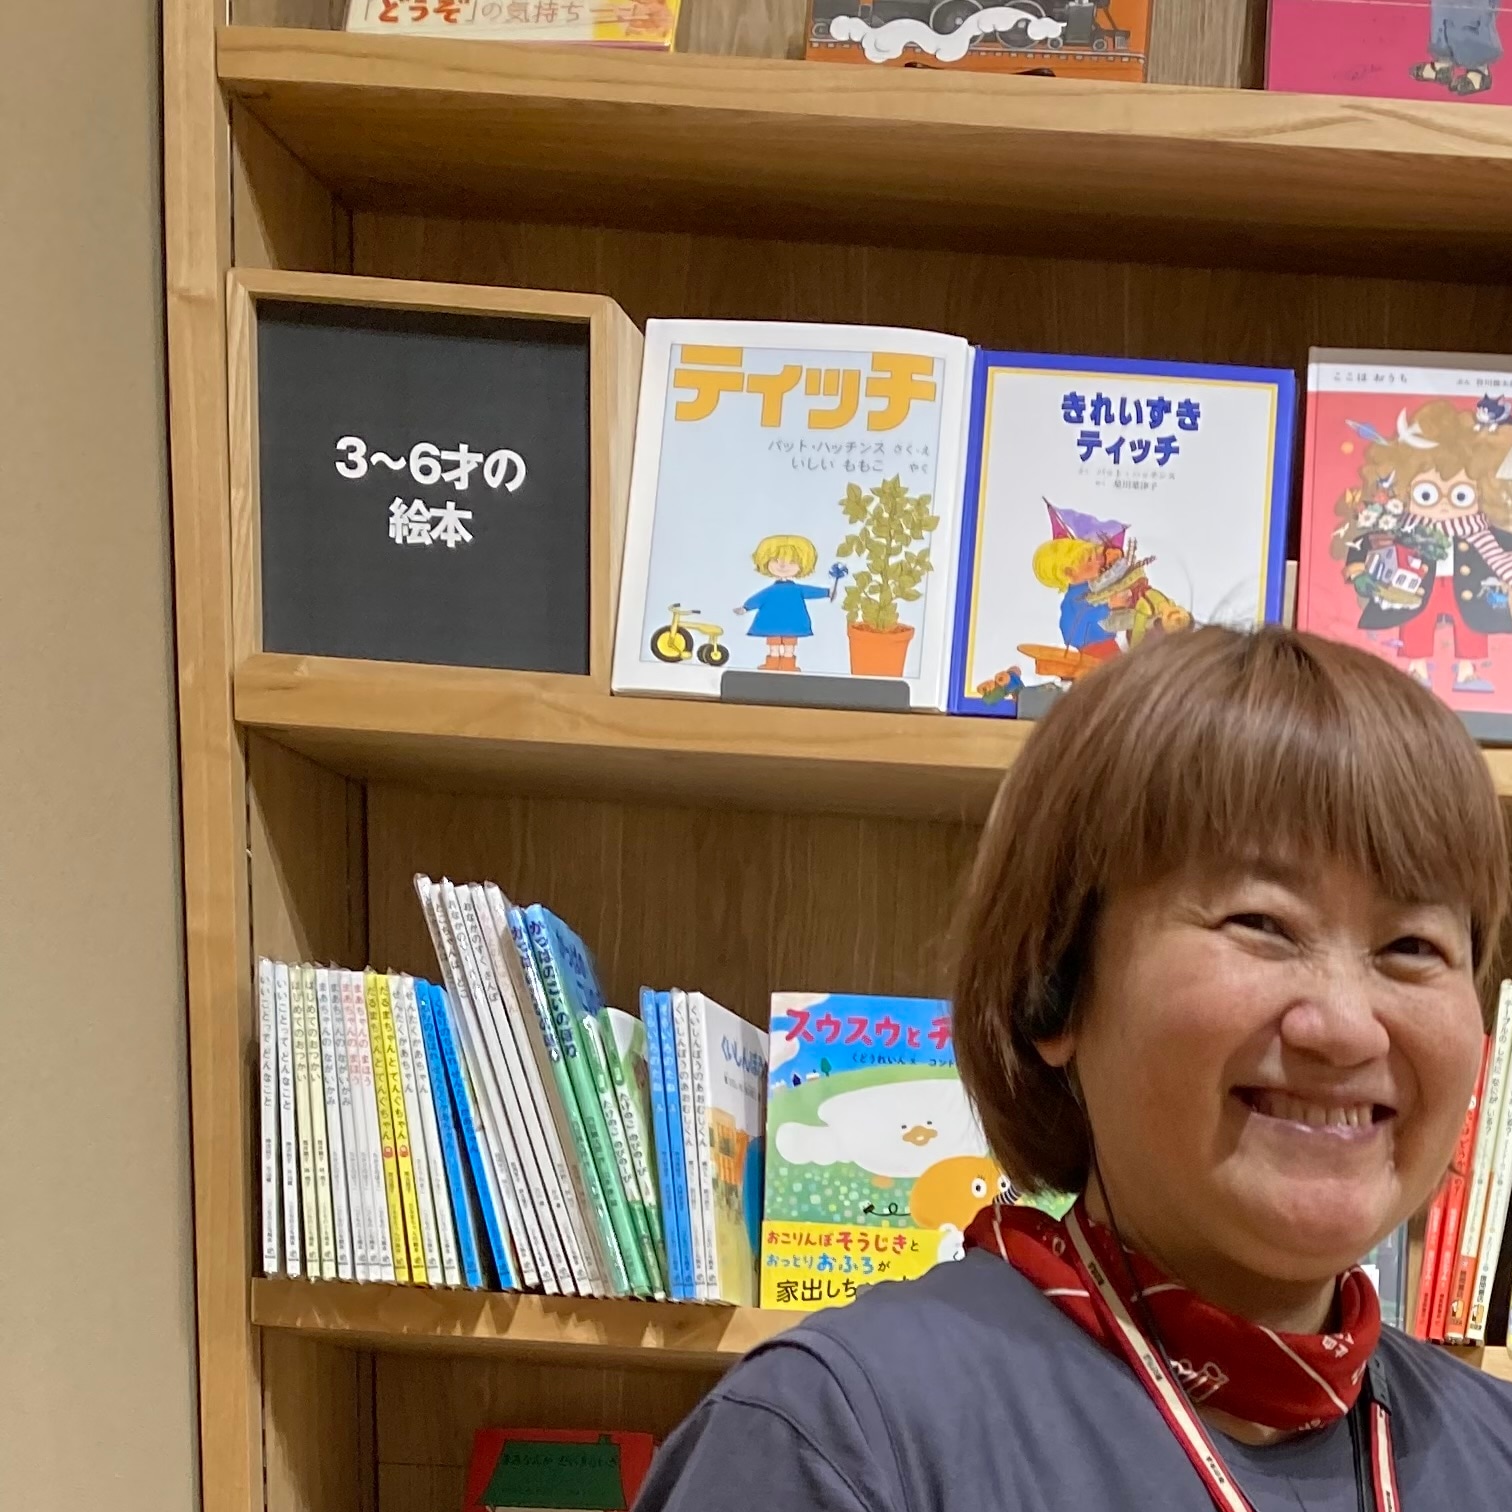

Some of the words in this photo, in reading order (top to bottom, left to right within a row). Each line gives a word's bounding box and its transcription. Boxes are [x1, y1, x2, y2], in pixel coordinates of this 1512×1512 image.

[673, 343, 937, 432] ティッチ
[1061, 390, 1202, 431] きれいすき
[791, 456, 834, 471] いしい
[843, 458, 884, 473] ももこ
[1076, 429, 1181, 467] ティッチ
[387, 496, 474, 548] 絵本
[291, 981, 307, 1083] はじめてのおつかい
[304, 980, 321, 1083] はじめてのおつかい
[602, 1099, 618, 1137] たけのこ
[619, 1092, 635, 1129] たけのこ
[767, 1231, 920, 1254] おこりんぼそうじきと
[766, 1253, 891, 1275] おっとりおふろが
